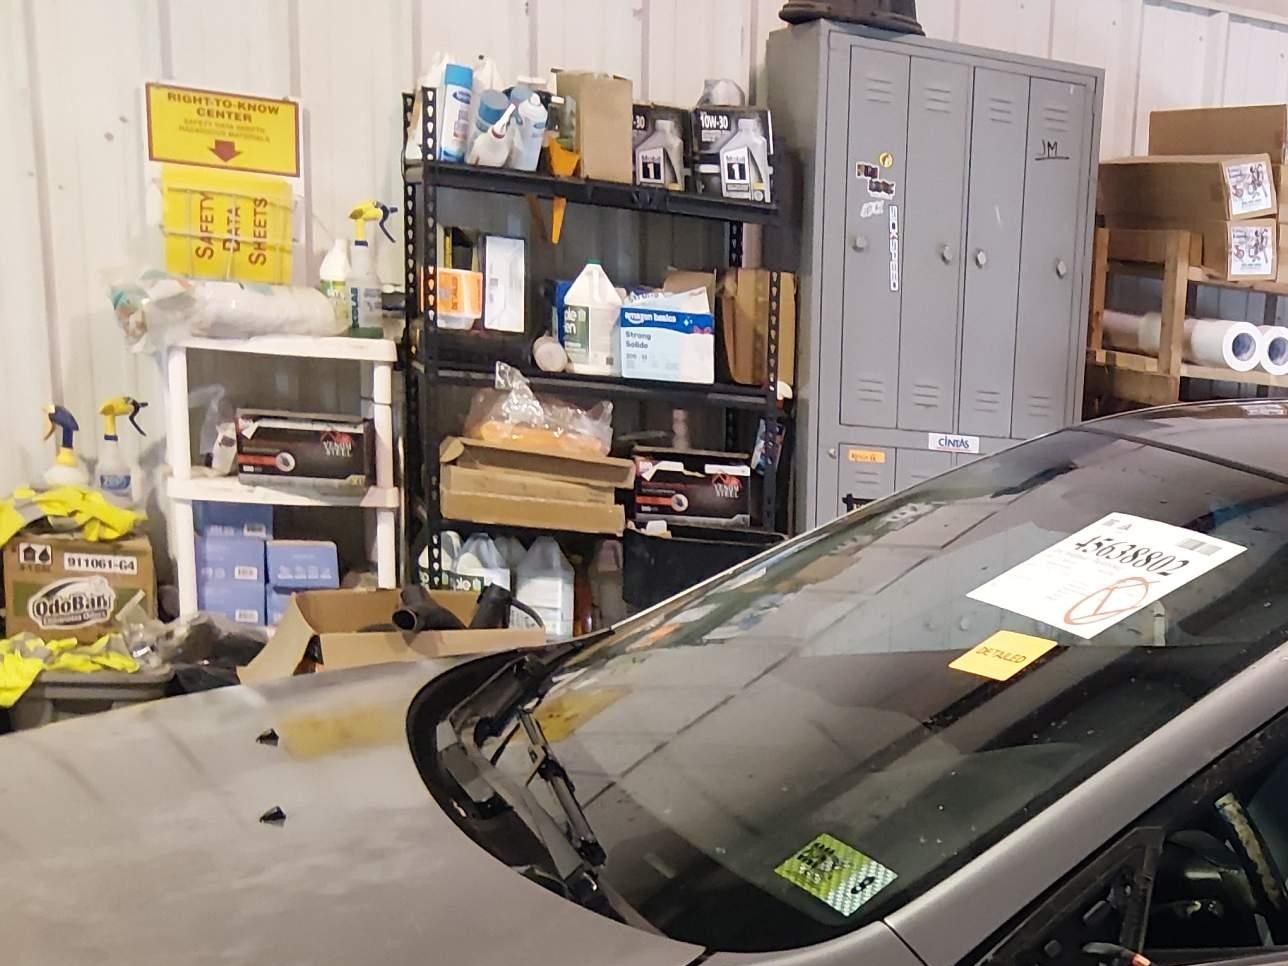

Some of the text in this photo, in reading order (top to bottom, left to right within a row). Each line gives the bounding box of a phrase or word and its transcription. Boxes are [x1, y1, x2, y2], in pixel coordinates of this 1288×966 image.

[167, 92, 280, 115] RIGHT-TO-KNOW
[196, 107, 253, 123] CENTER
[700, 113, 729, 129] 10W-30
[195, 191, 214, 260] SAFETY
[222, 207, 241, 252] DATA
[248, 197, 268, 266] SHEETS
[624, 312, 677, 323] amazon basics
[625, 330, 652, 341] Strong
[625, 340, 649, 349] Solide
[67, 557, 136, 571] 911061-G4
[1074, 535, 1190, 576] 45638802
[35, 595, 110, 617] OdoBan
[975, 646, 1028, 665] DETAILED
